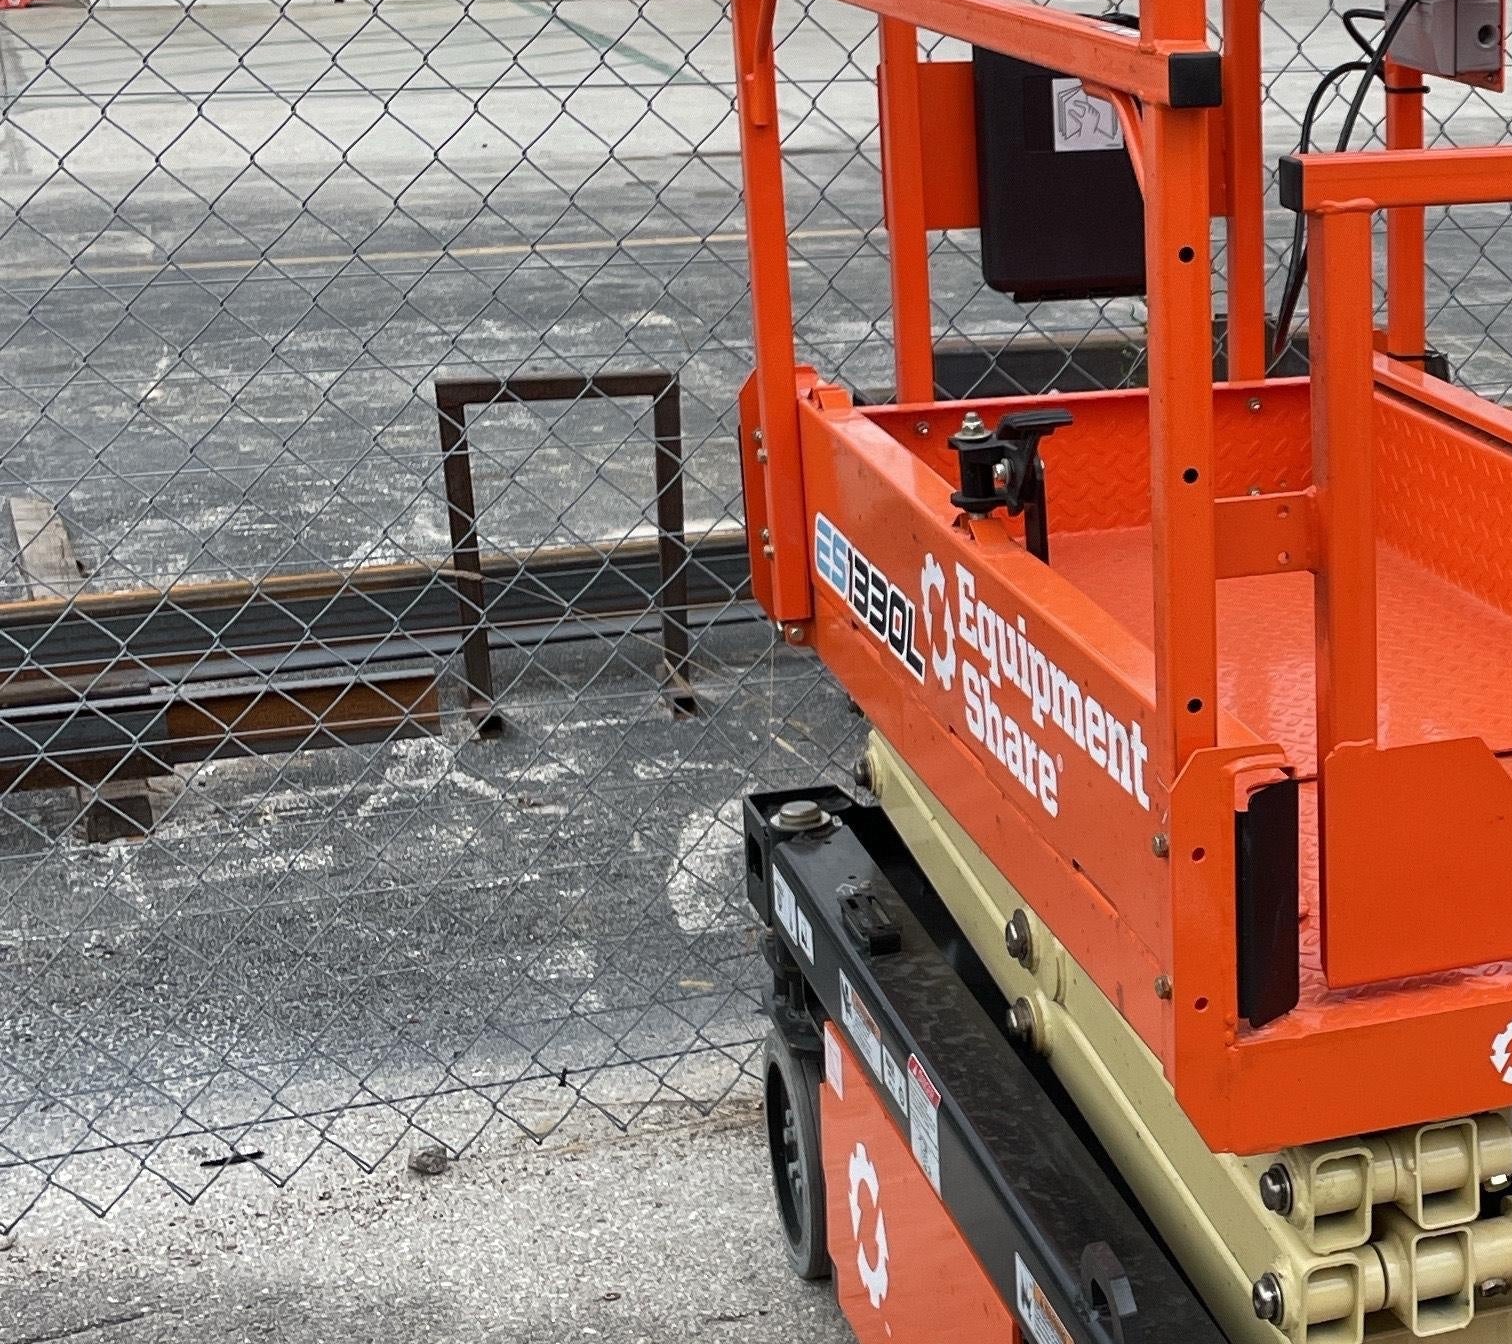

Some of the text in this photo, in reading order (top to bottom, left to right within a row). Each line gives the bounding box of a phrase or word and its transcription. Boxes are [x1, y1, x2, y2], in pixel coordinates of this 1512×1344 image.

[815, 511, 926, 686] ES1330L
[955, 560, 1151, 812] Equipment
[962, 658, 1060, 819] Share
